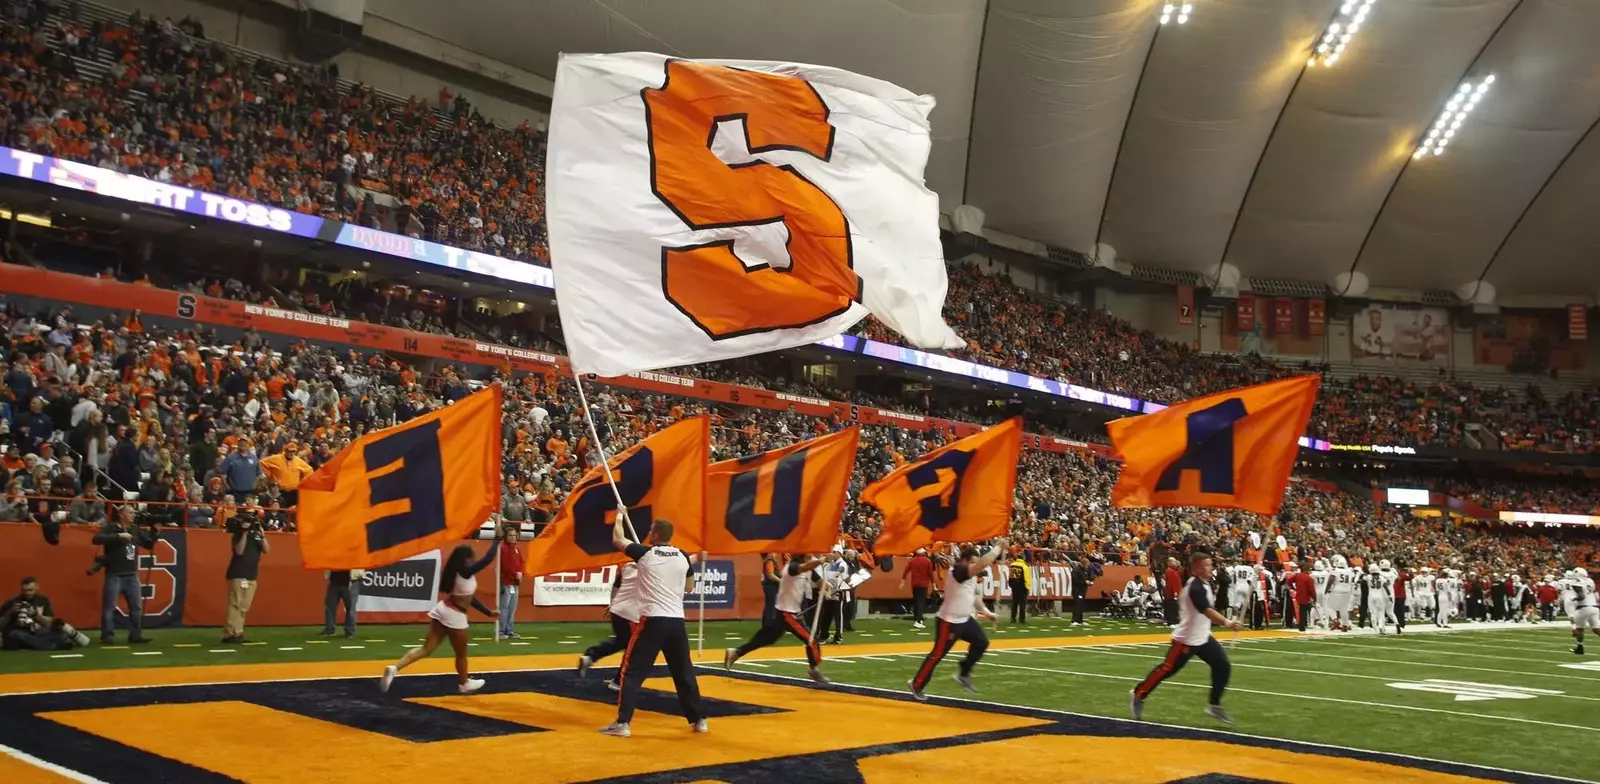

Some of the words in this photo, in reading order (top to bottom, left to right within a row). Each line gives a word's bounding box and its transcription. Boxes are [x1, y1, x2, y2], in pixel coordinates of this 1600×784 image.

[641, 58, 863, 341] S
[201, 192, 291, 231] TOSS
[177, 293, 196, 319] S
[244, 305, 263, 315] NEW
[264, 308, 293, 320] YORK'S
[294, 312, 328, 325] COLLEGE
[329, 317, 349, 328] TEAM
[1182, 306, 1188, 316] 7
[404, 338, 417, 351] 114
[476, 343, 489, 352] NEW
[490, 346, 512, 355] YORK'S
[513, 349, 539, 360] COLLEGE
[540, 353, 555, 363] TEAM
[362, 571, 424, 587] StubHub
